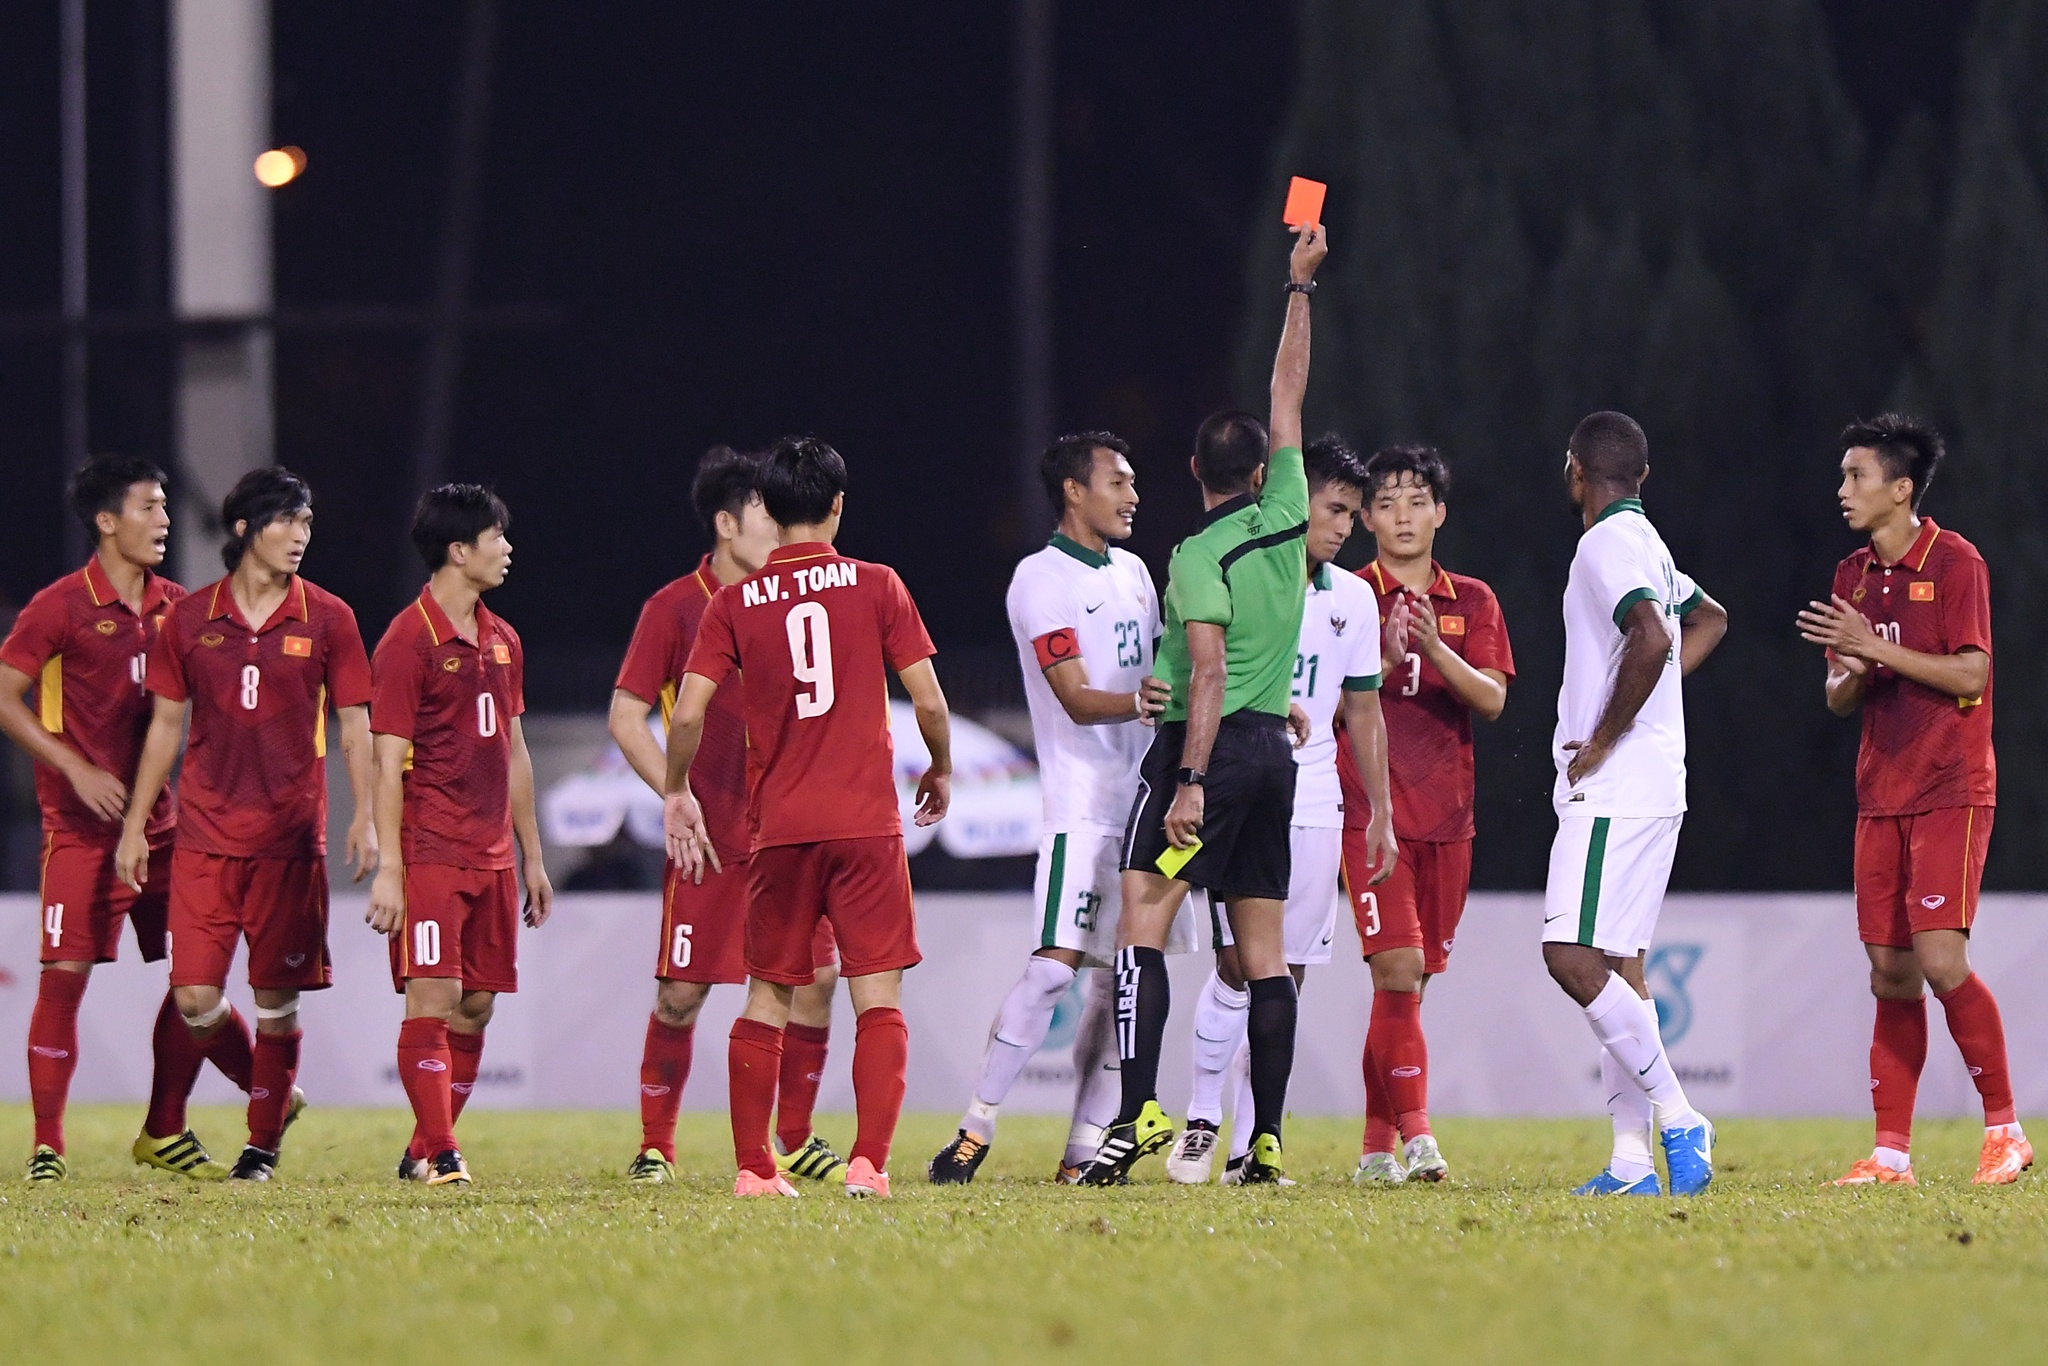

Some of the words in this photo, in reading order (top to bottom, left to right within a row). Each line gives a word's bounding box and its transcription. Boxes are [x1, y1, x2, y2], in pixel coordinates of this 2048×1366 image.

[742, 574, 789, 608] N.V.
[793, 562, 858, 596] TOAN
[785, 601, 834, 720] 9
[1047, 632, 1072, 658] C
[1114, 619, 1143, 668] 23
[241, 665, 260, 710] 8
[1402, 652, 1421, 697] 3
[45, 902, 65, 948] 4
[1361, 892, 1381, 937] 3
[414, 920, 440, 966] 10
[672, 923, 693, 968] 6
[1118, 983, 1140, 1021] FBT
